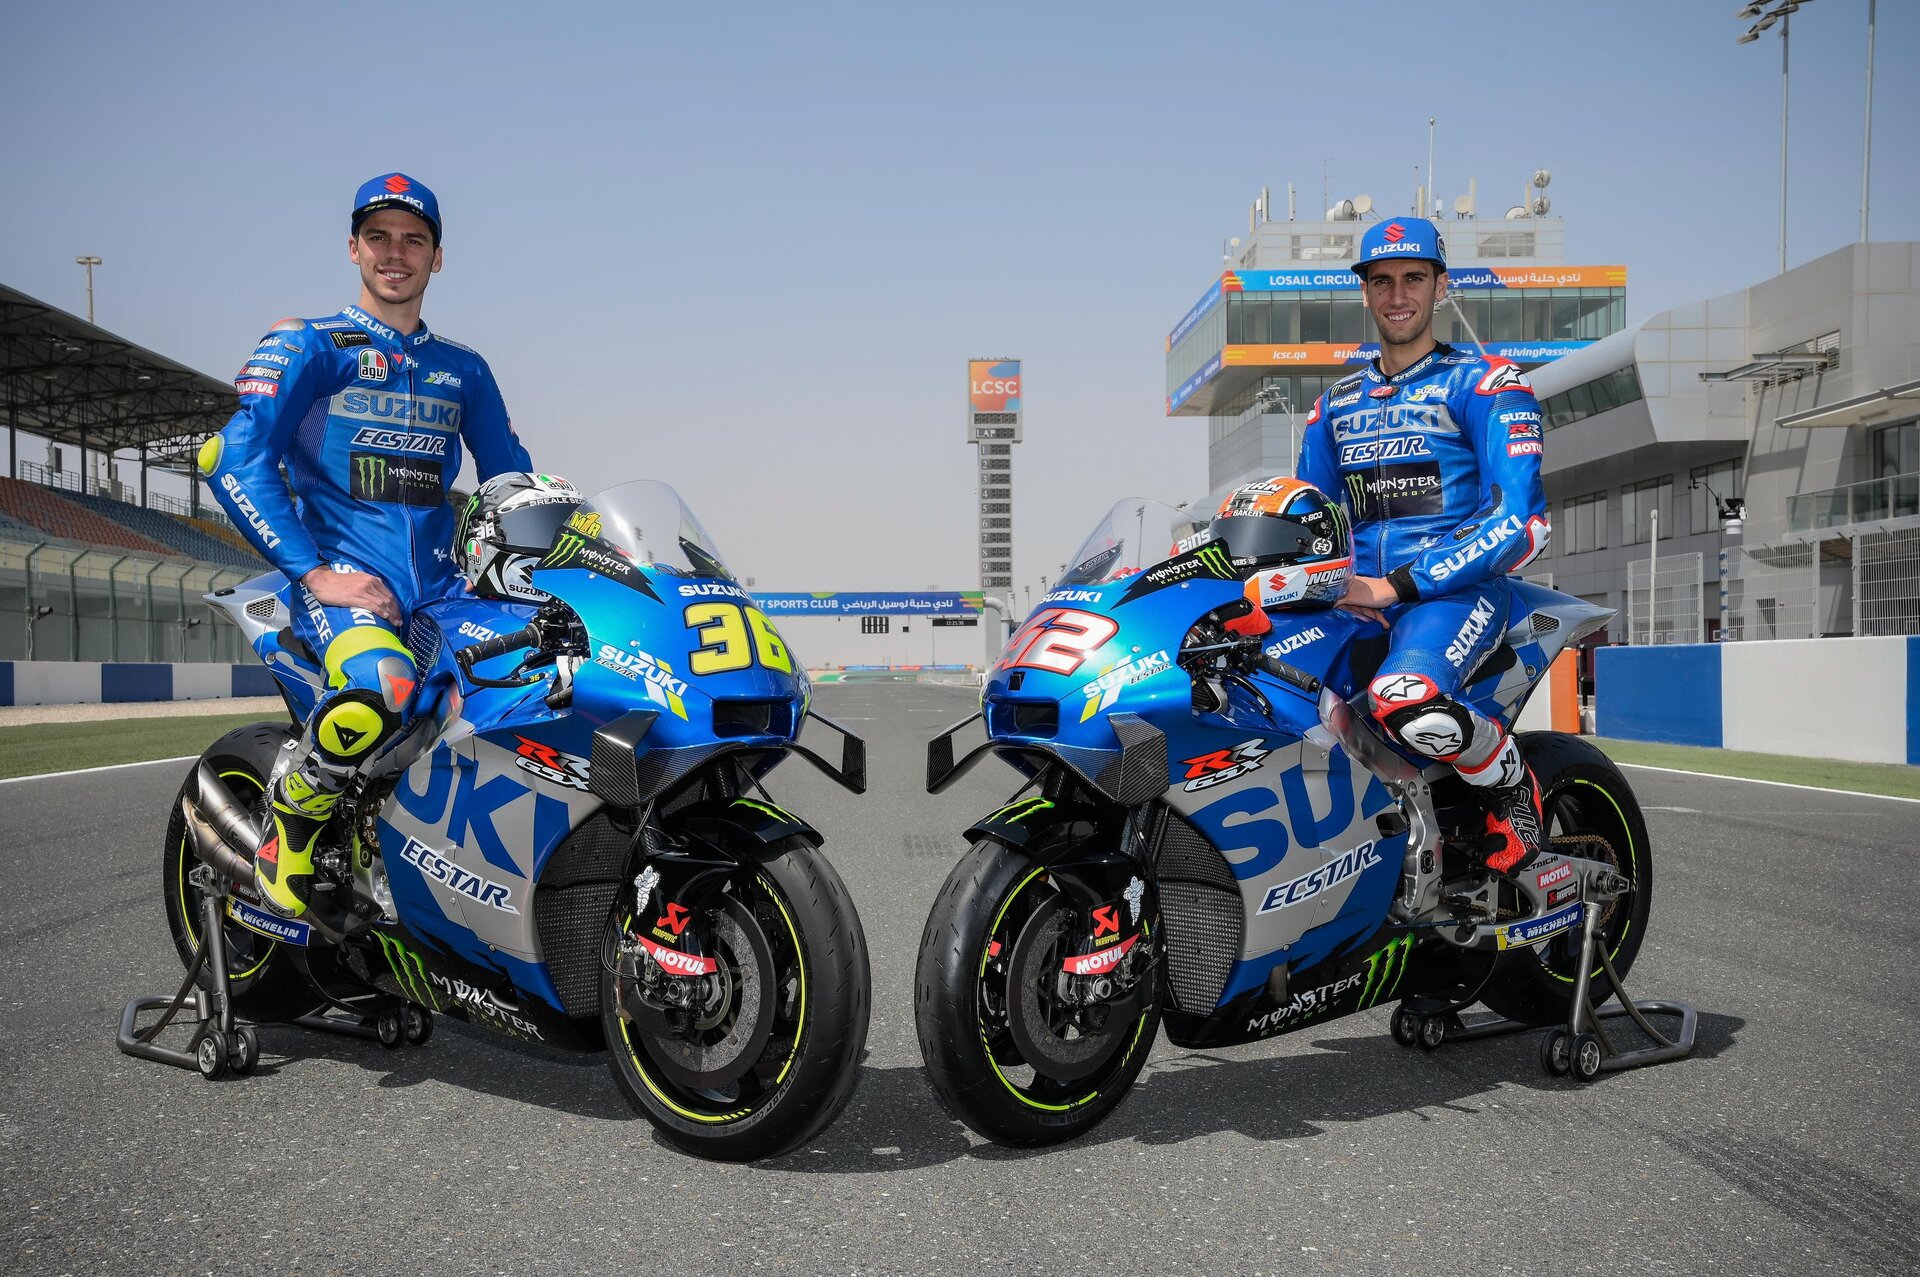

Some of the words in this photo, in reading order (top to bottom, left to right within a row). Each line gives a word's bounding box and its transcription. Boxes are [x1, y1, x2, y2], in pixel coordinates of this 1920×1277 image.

[1371, 243, 1421, 257] SUZUKI
[1270, 275, 1311, 286] LOSAIL
[342, 306, 396, 340] SUZUKI
[362, 366, 384, 379] agv
[429, 371, 461, 384] SUZUKI
[973, 381, 1017, 394] LCSC
[1414, 386, 1450, 396] SUZUKI
[343, 392, 459, 427] SUZUKI
[976, 429, 996, 438] LAP
[1336, 409, 1440, 438] SUZUKI
[351, 427, 447, 455] ECSTAR
[1340, 436, 1431, 465] ECSTAR
[388, 467, 440, 484] MONSTER
[220, 473, 281, 549] SUZUKI
[1301, 511, 1323, 524] X-803
[1430, 514, 1523, 581] SUZUKI
[579, 547, 631, 575] MONSTER
[580, 559, 617, 576] ENERGY
[1146, 558, 1203, 583] MONSTER
[983, 578, 992, 587] 10
[1161, 569, 1198, 585] ENERGY
[508, 584, 553, 599] SUZUKI
[678, 583, 750, 599] SUZUKI
[1039, 590, 1103, 605] SUZUKI
[1263, 591, 1299, 605] SUZUKI
[767, 599, 809, 609] SPORTS
[810, 599, 839, 609] CLUB
[842, 600, 877, 612] الرياضي
[878, 600, 909, 609] لوسيل
[909, 600, 932, 608] حلبة
[932, 599, 954, 611] نادي
[684, 602, 793, 676] 36
[1265, 626, 1326, 660] SUZUKI
[1445, 596, 1496, 667] SUZUKI
[594, 657, 637, 682] ECSTAR
[599, 645, 688, 697] SUZUKI
[1083, 650, 1170, 699] SUZUKI
[1129, 662, 1173, 686] ECSTAR
[515, 756, 590, 791] GSX
[1184, 758, 1266, 793] GSX
[1530, 855, 1559, 869] TAICHI
[400, 835, 521, 915] ECSTAR
[1257, 839, 1383, 916] ECSTAR
[1540, 865, 1571, 887] MOTUL
[244, 913, 300, 939] MICHELIN
[1526, 911, 1578, 938] MICHELIN
[654, 947, 705, 975] MOTUL
[1075, 946, 1124, 975] MOTUL
[429, 971, 545, 1041] MONSTER
[1246, 972, 1362, 1032] MONSTER
